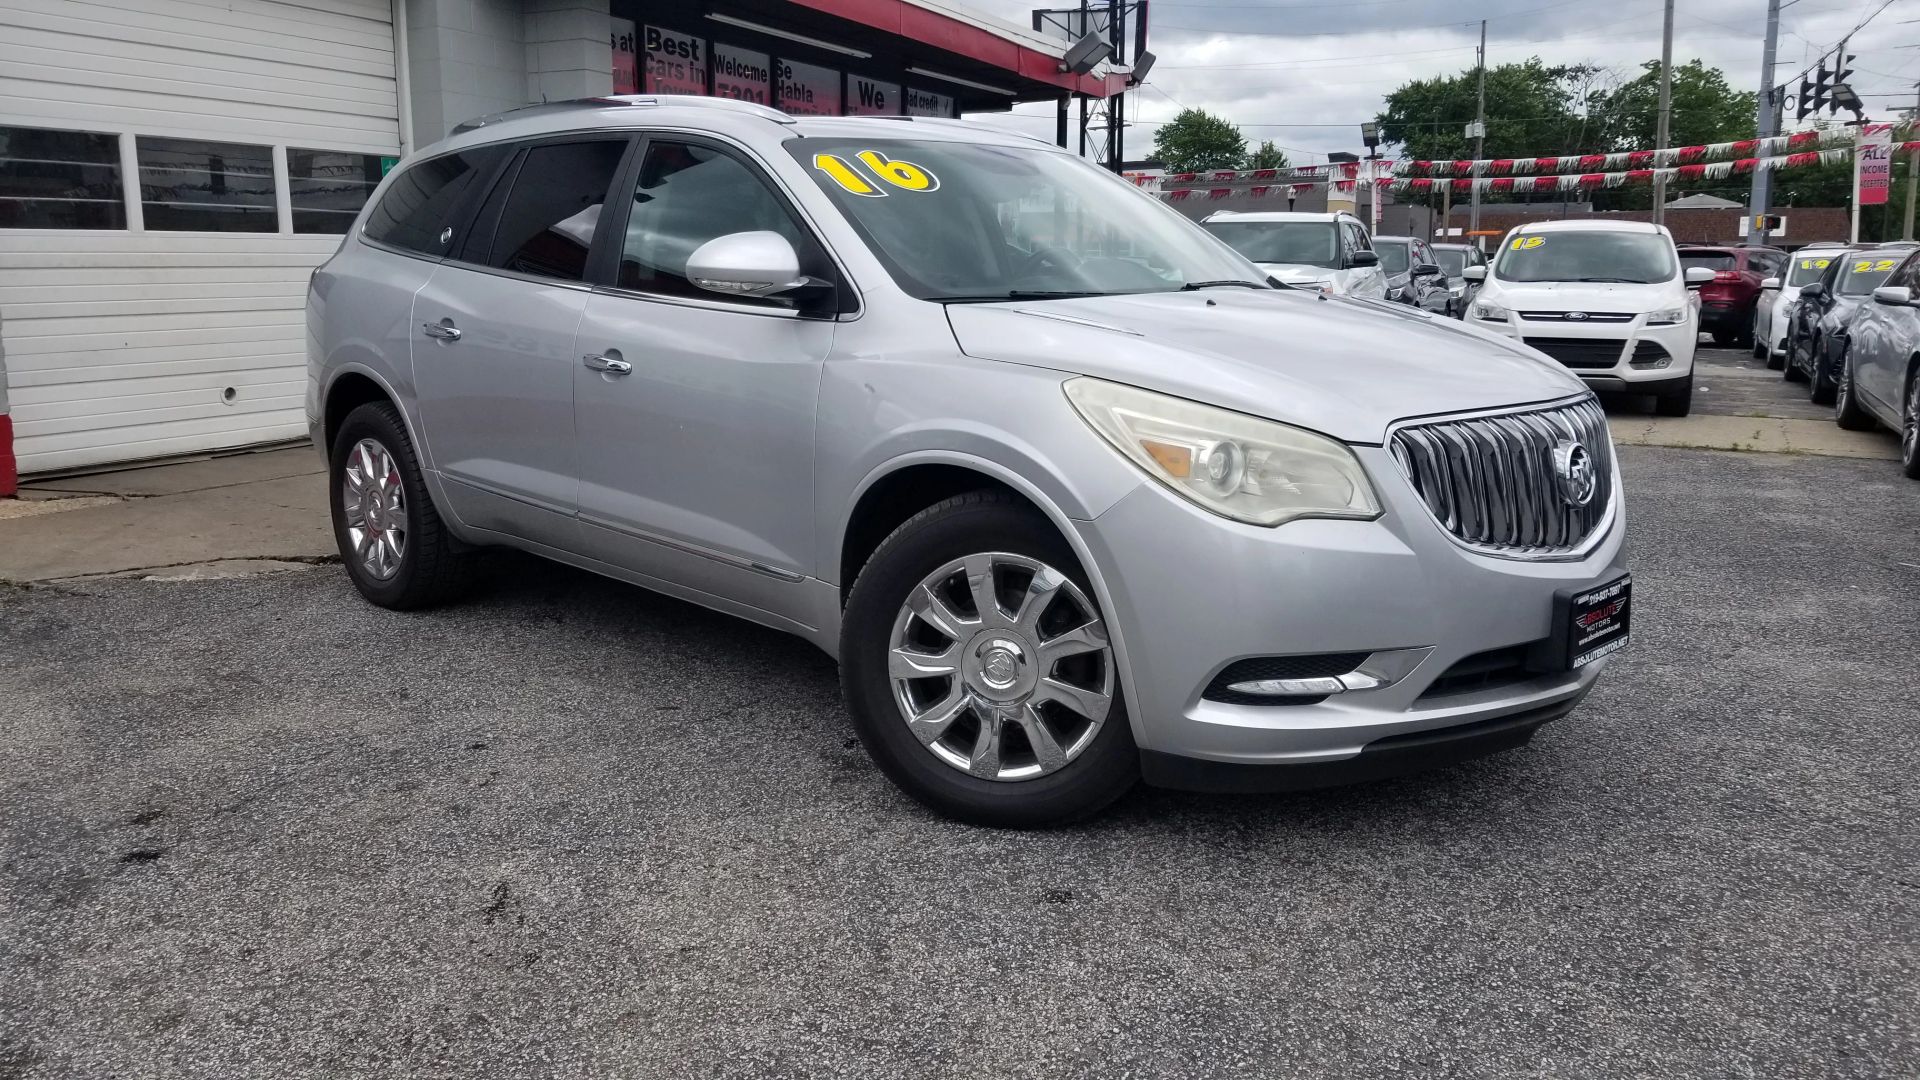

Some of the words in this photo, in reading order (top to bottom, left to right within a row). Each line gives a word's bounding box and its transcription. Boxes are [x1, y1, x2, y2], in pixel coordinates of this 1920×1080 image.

[620, 32, 634, 53] at
[646, 26, 700, 62] Best
[645, 52, 685, 81] Cars
[690, 61, 706, 87] in
[714, 54, 768, 83] Welcome
[776, 60, 792, 80] Se
[776, 79, 814, 103] Habla
[858, 81, 885, 110] We
[905, 90, 918, 108] ad
[1863, 149, 1887, 160] ALL
[813, 150, 941, 197] 16
[1860, 164, 1888, 174] INCOME
[1801, 260, 1831, 269] 19
[1854, 260, 1896, 273] 22
[1586, 617, 1611, 632] MOTORS
